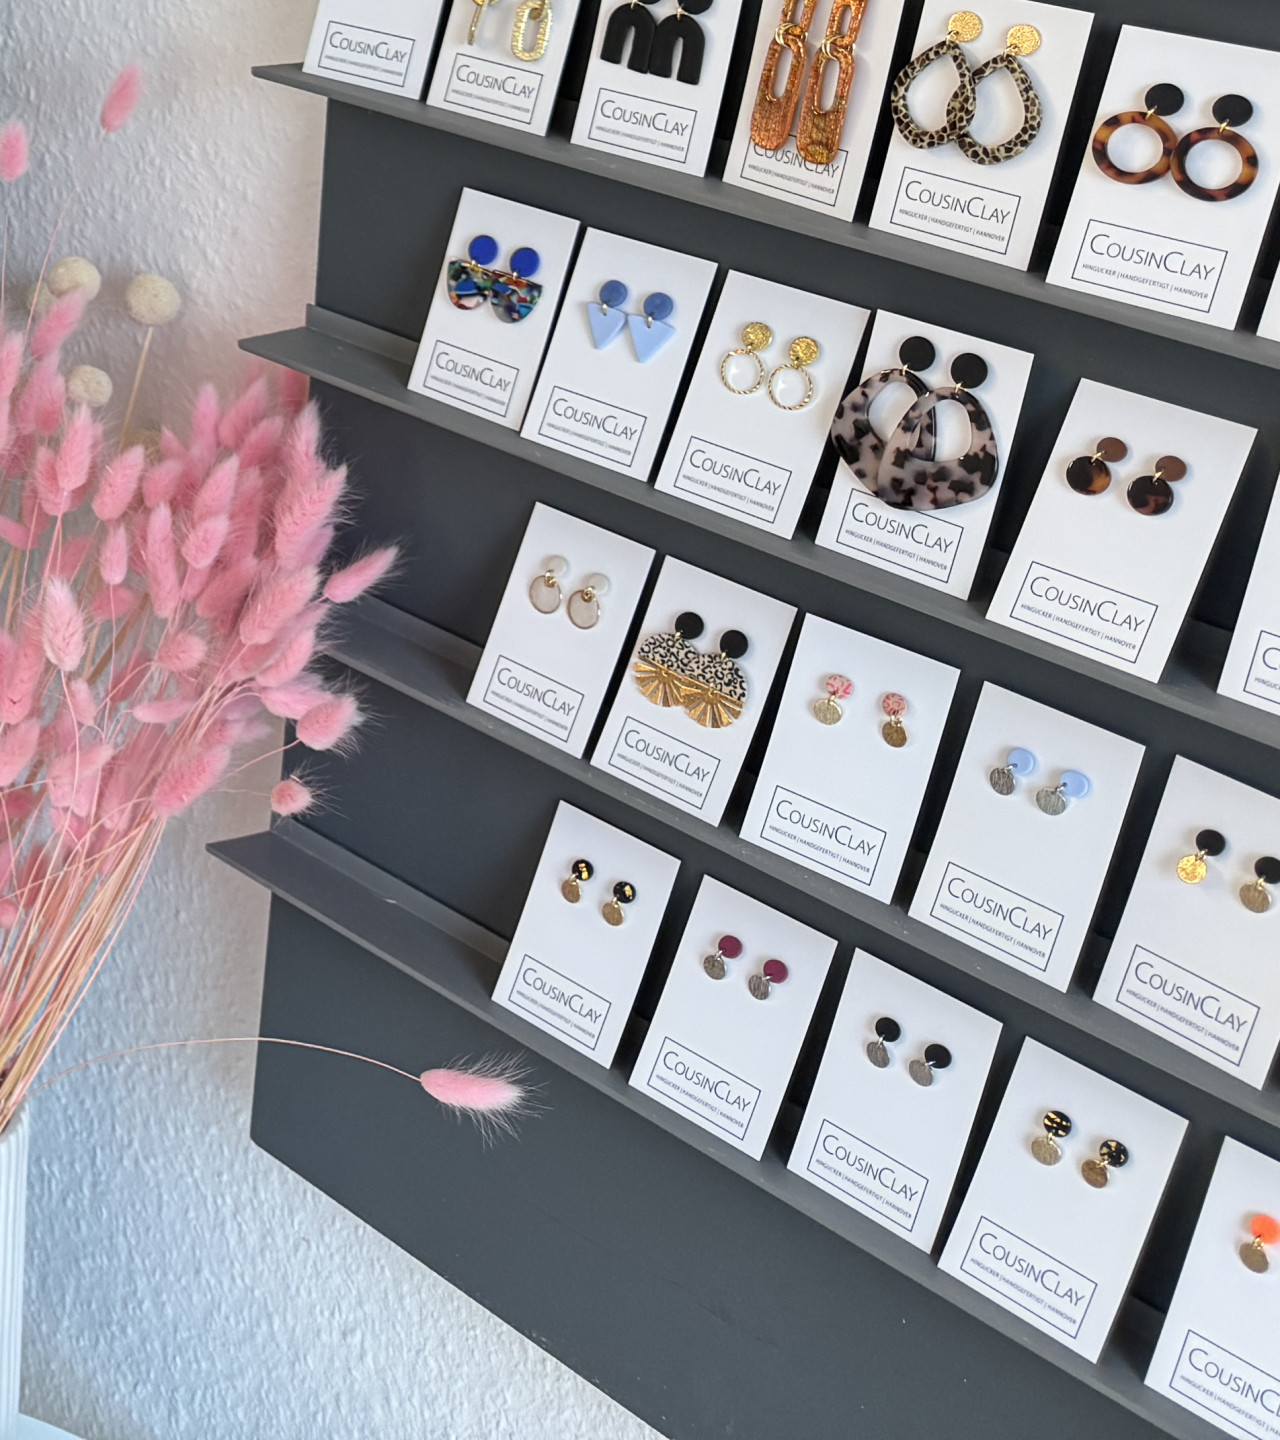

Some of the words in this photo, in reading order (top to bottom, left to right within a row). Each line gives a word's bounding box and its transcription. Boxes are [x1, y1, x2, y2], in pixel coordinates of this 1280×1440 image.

[930, 216, 972, 233] HANDGEFERTIGT
[975, 229, 1004, 242] HANNOVER
[1081, 263, 1115, 276] HINGUCKER
[1119, 272, 1168, 290] HANDGEFERTIGT
[1172, 285, 1208, 299] HANNOVER
[919, 555, 947, 570] HANNOVER
[1054, 615, 1101, 637] HANDGEFERTIGT
[1104, 633, 1136, 650] HANNOVER
[842, 856, 869, 873] HANNOVER
